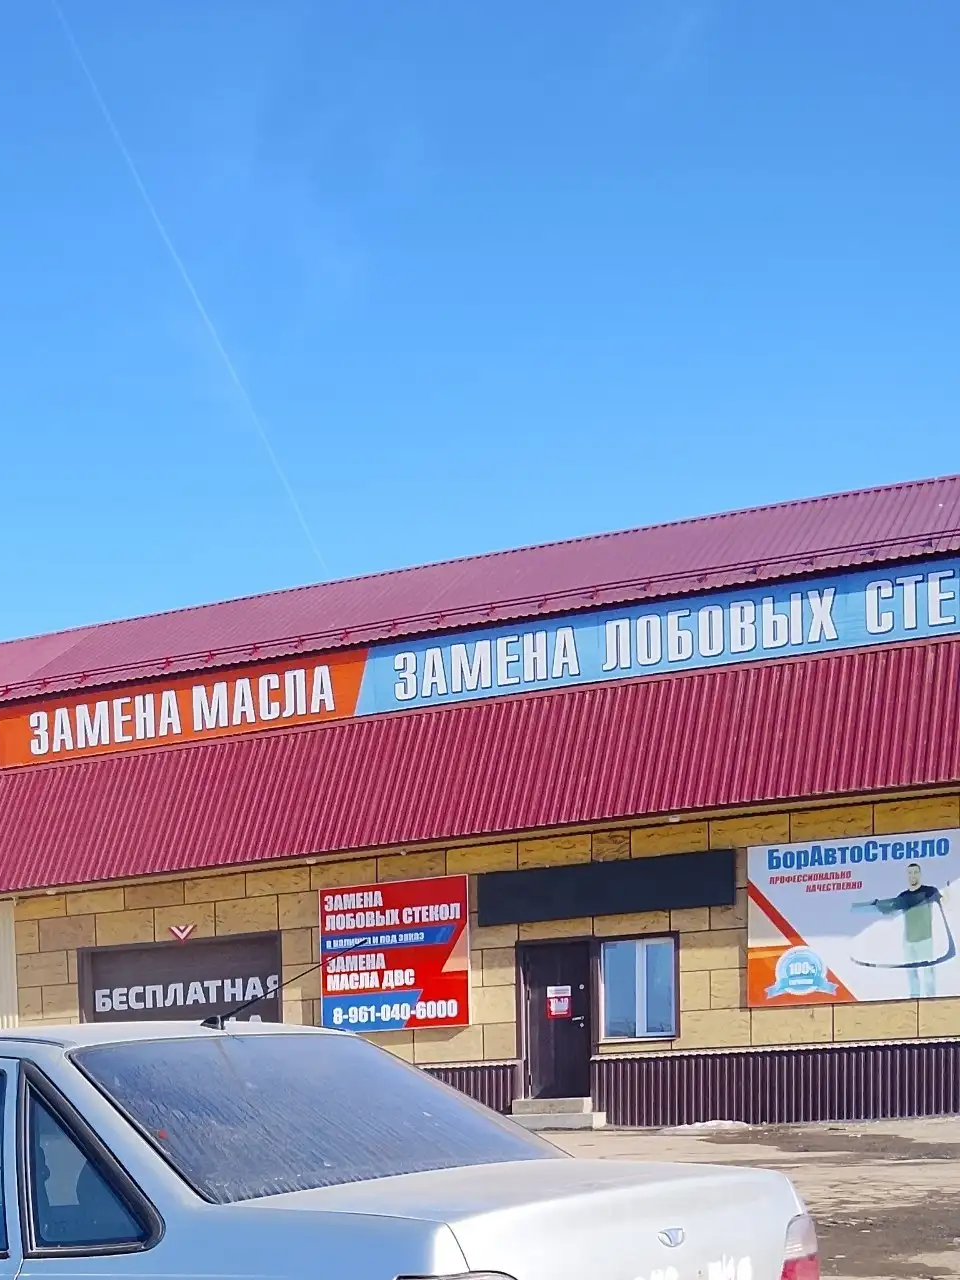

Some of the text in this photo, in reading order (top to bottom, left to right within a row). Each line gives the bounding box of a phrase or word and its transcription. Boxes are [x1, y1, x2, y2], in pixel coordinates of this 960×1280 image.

[394, 628, 580, 700] ЗАМЕНА
[602, 587, 838, 671] ЛОБОВЫХ
[29, 664, 335, 756] ЗАМЕНА МАСЛА
[767, 837, 950, 870] БорАвтоСтекло
[769, 870, 852, 885] ПРОФЕССИОНАЛЬНО
[805, 881, 863, 893] КАЧЕСТВЕННО
[324, 890, 384, 912] ЗАМЕНА
[324, 903, 461, 932] ЛОБОВЫХ СТЕКОЛ
[326, 952, 386, 974] ЗАМЕНА
[95, 974, 279, 1012] БЕСПЛАТНАЯ
[326, 968, 416, 992] МАСЛА ДВС
[332, 999, 458, 1025] 8-961-040-6000
